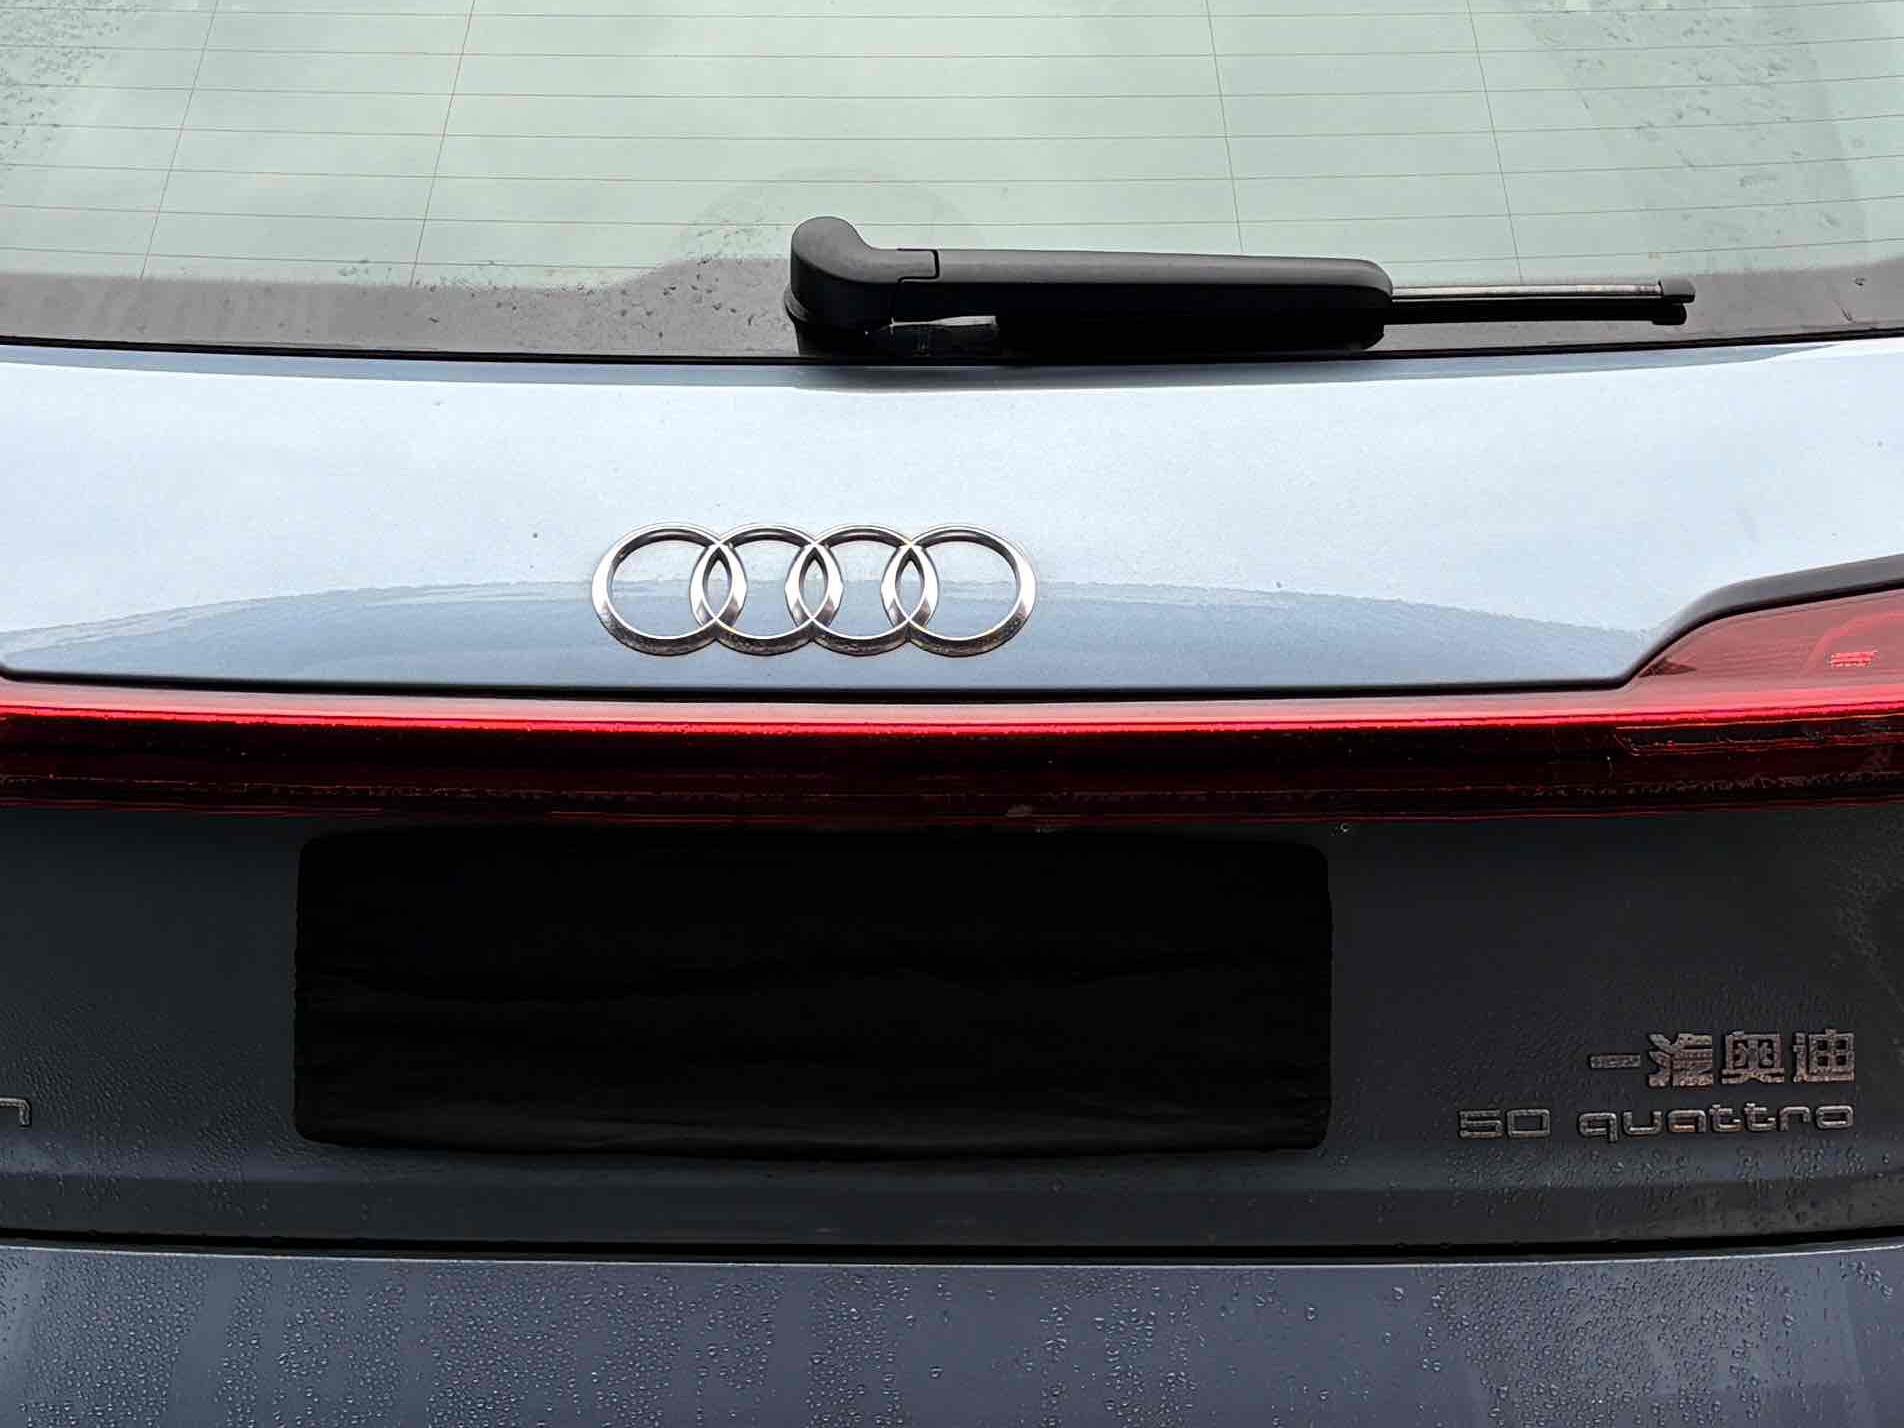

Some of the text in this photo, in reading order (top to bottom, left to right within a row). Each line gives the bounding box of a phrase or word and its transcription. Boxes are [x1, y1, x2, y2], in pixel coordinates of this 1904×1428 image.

[1589, 1028, 1856, 1087] 一汽奥迪
[1458, 1102, 1854, 1143] 50 quattro
